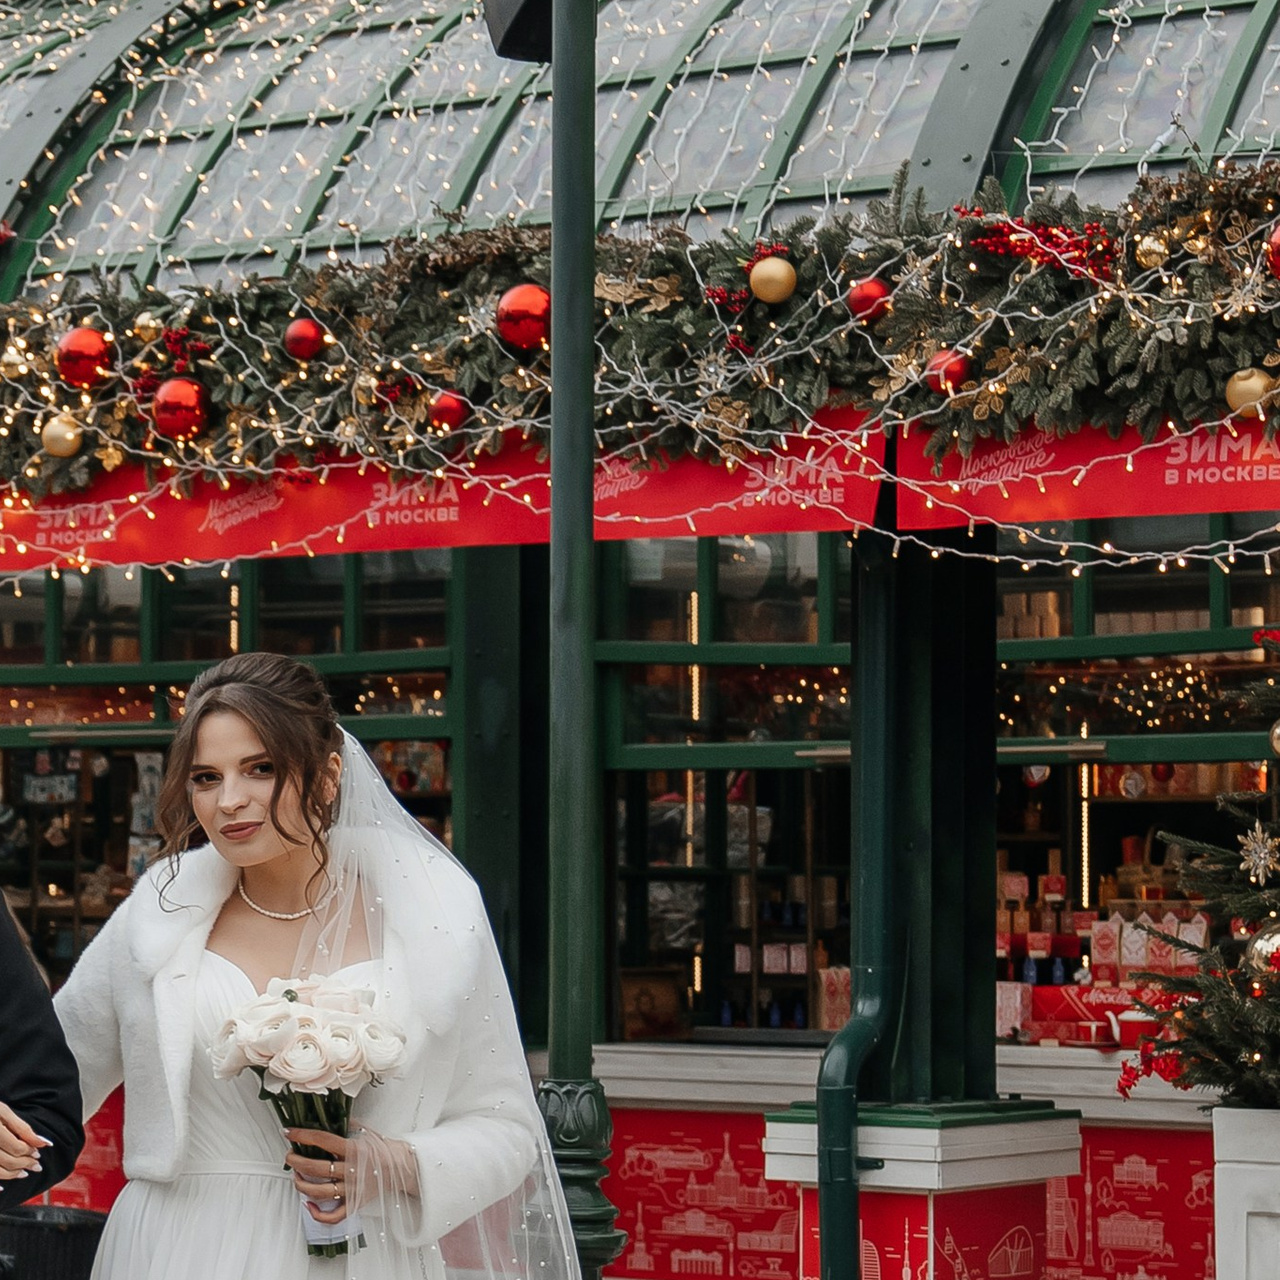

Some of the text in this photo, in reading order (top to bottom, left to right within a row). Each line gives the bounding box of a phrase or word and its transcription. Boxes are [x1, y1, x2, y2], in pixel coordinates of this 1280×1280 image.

[1165, 433, 1280, 465] ЗИМА
[743, 456, 845, 489] ЗИМА
[1164, 464, 1280, 485] В МОСКВЕ
[369, 479, 460, 508] ЗИМА
[761, 487, 845, 507] МОСКВЕ
[385, 506, 460, 525] МОСКВЕ
[50, 529, 117, 545] МОСК
